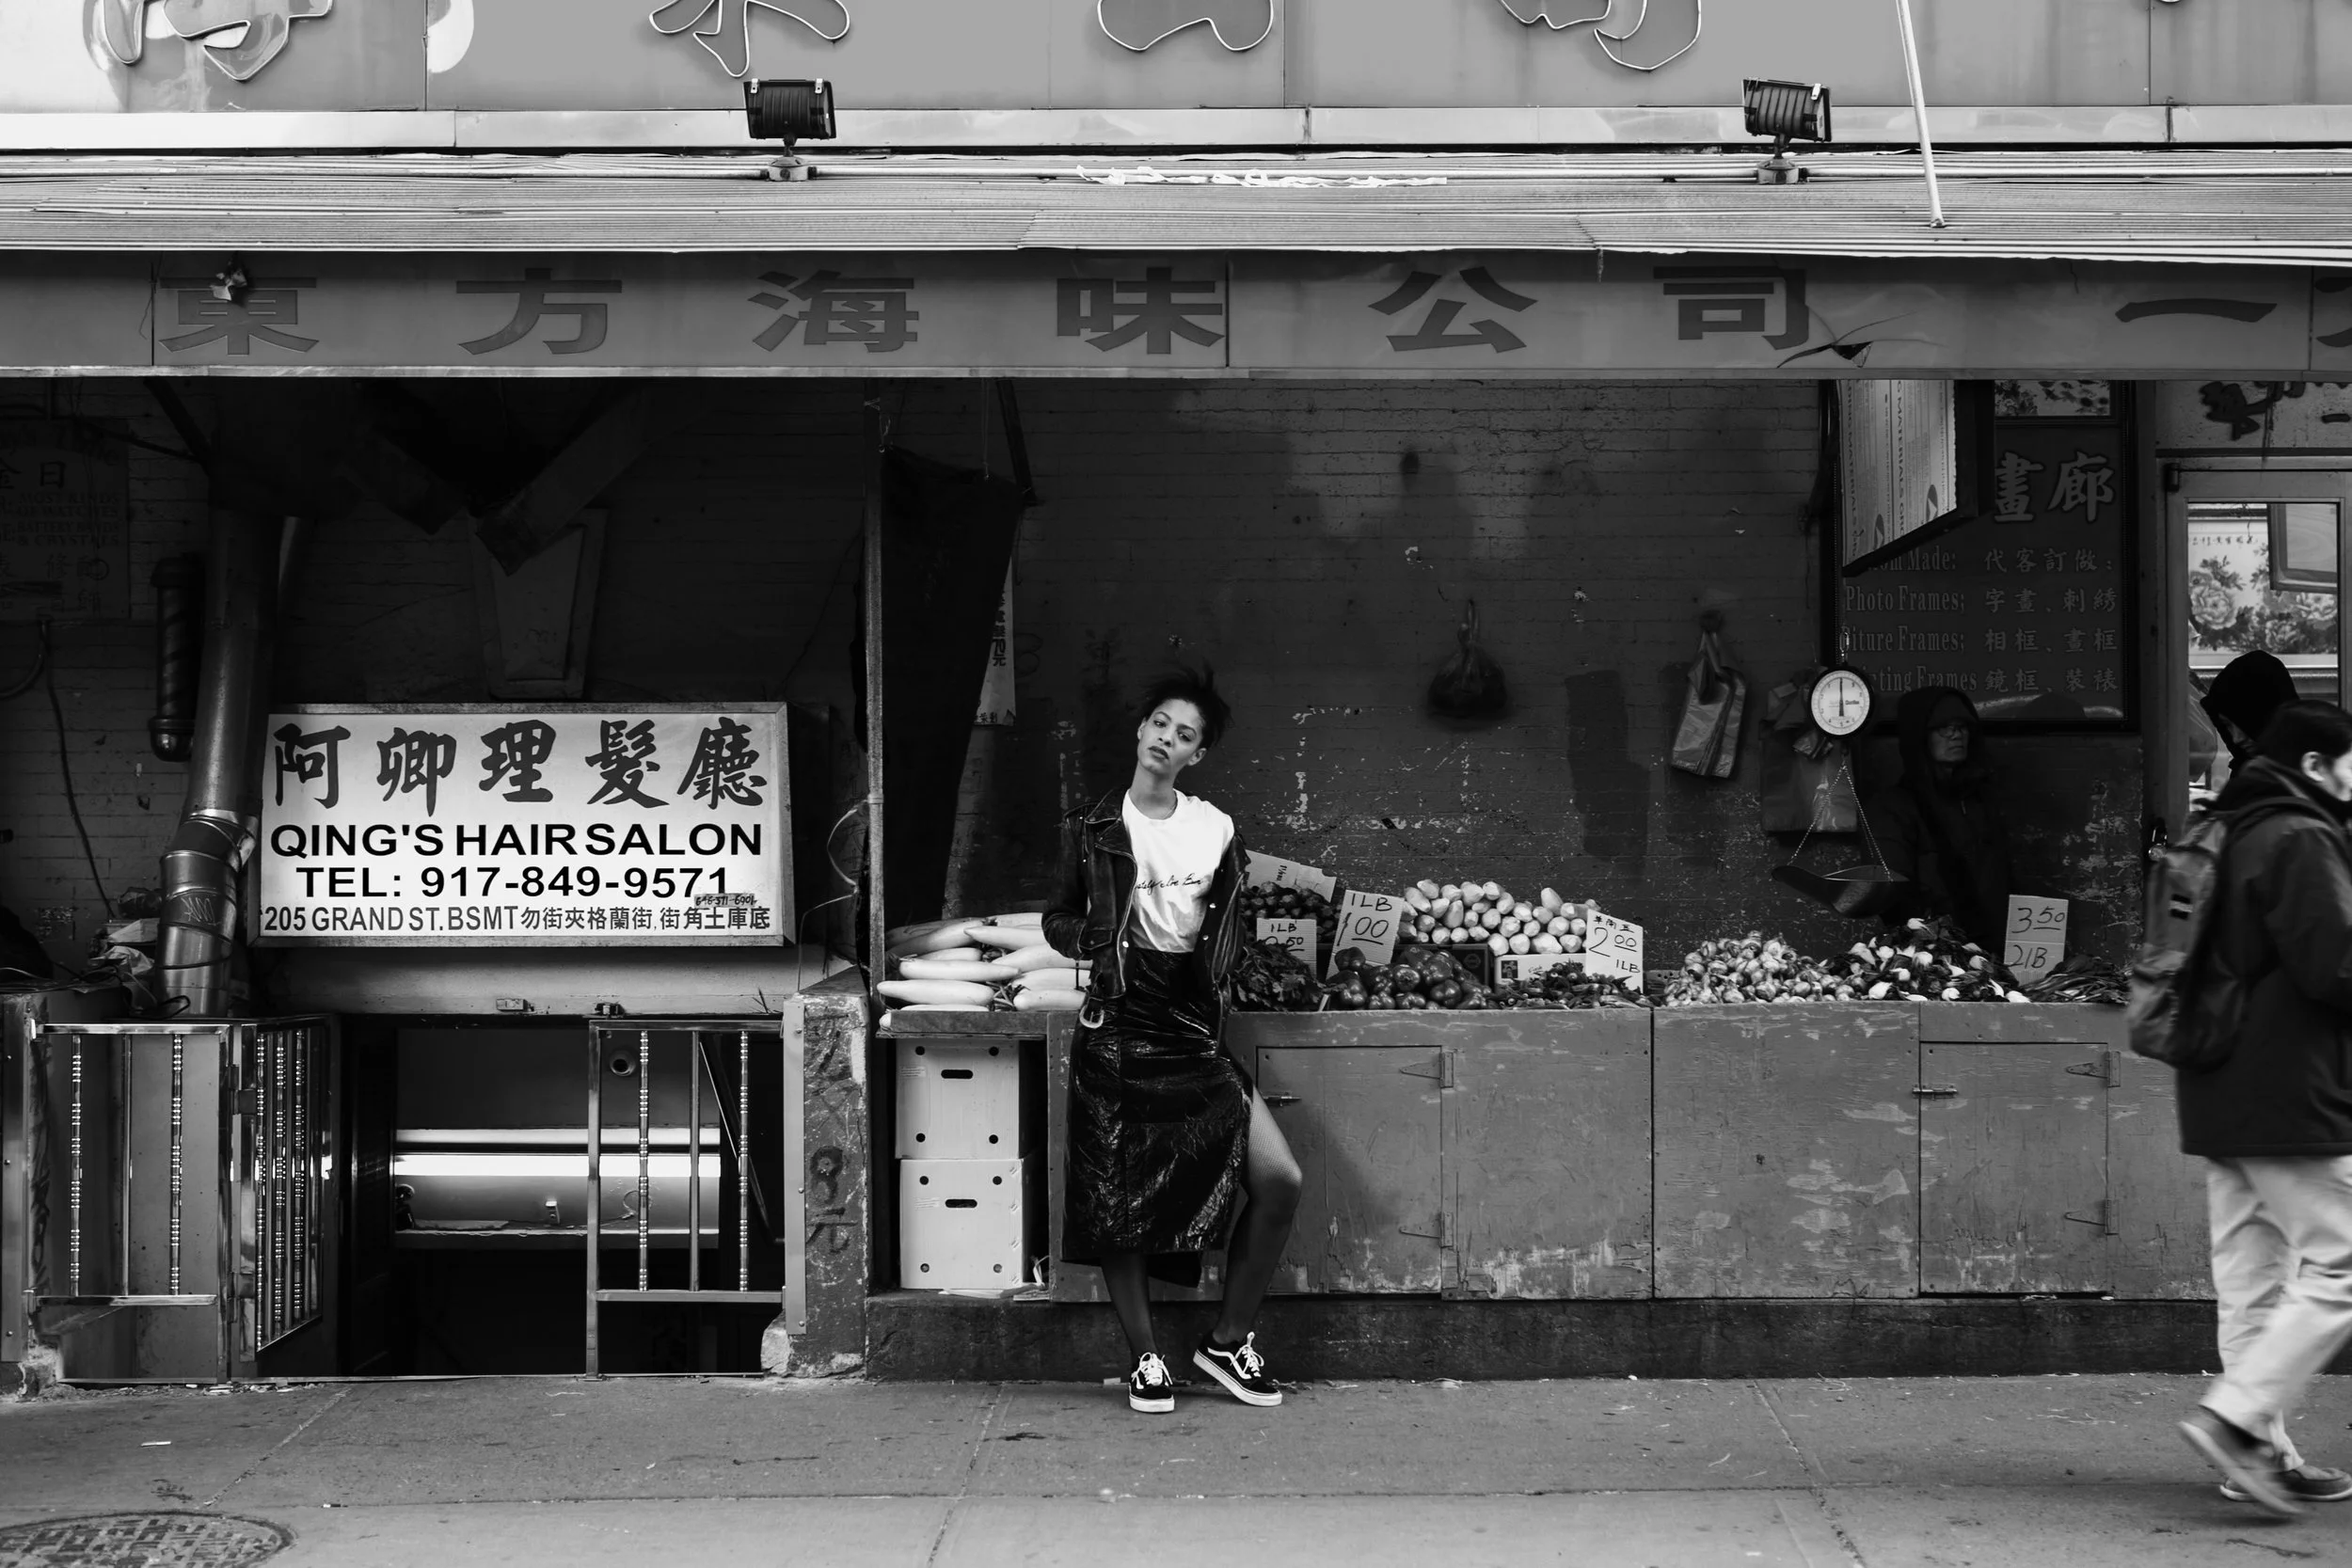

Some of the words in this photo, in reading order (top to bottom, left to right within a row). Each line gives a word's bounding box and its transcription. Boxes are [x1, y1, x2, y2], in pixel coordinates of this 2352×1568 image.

[1994, 451, 2114, 522] 畫廊
[1845, 585, 1894, 611] Photo
[273, 716, 768, 816] 阿卿理髮廳
[270, 823, 444, 860] QING'S
[295, 866, 403, 898] TEL:
[420, 865, 731, 898] 917-849-9571
[264, 906, 307, 931] 205
[311, 906, 404, 931] GRAND
